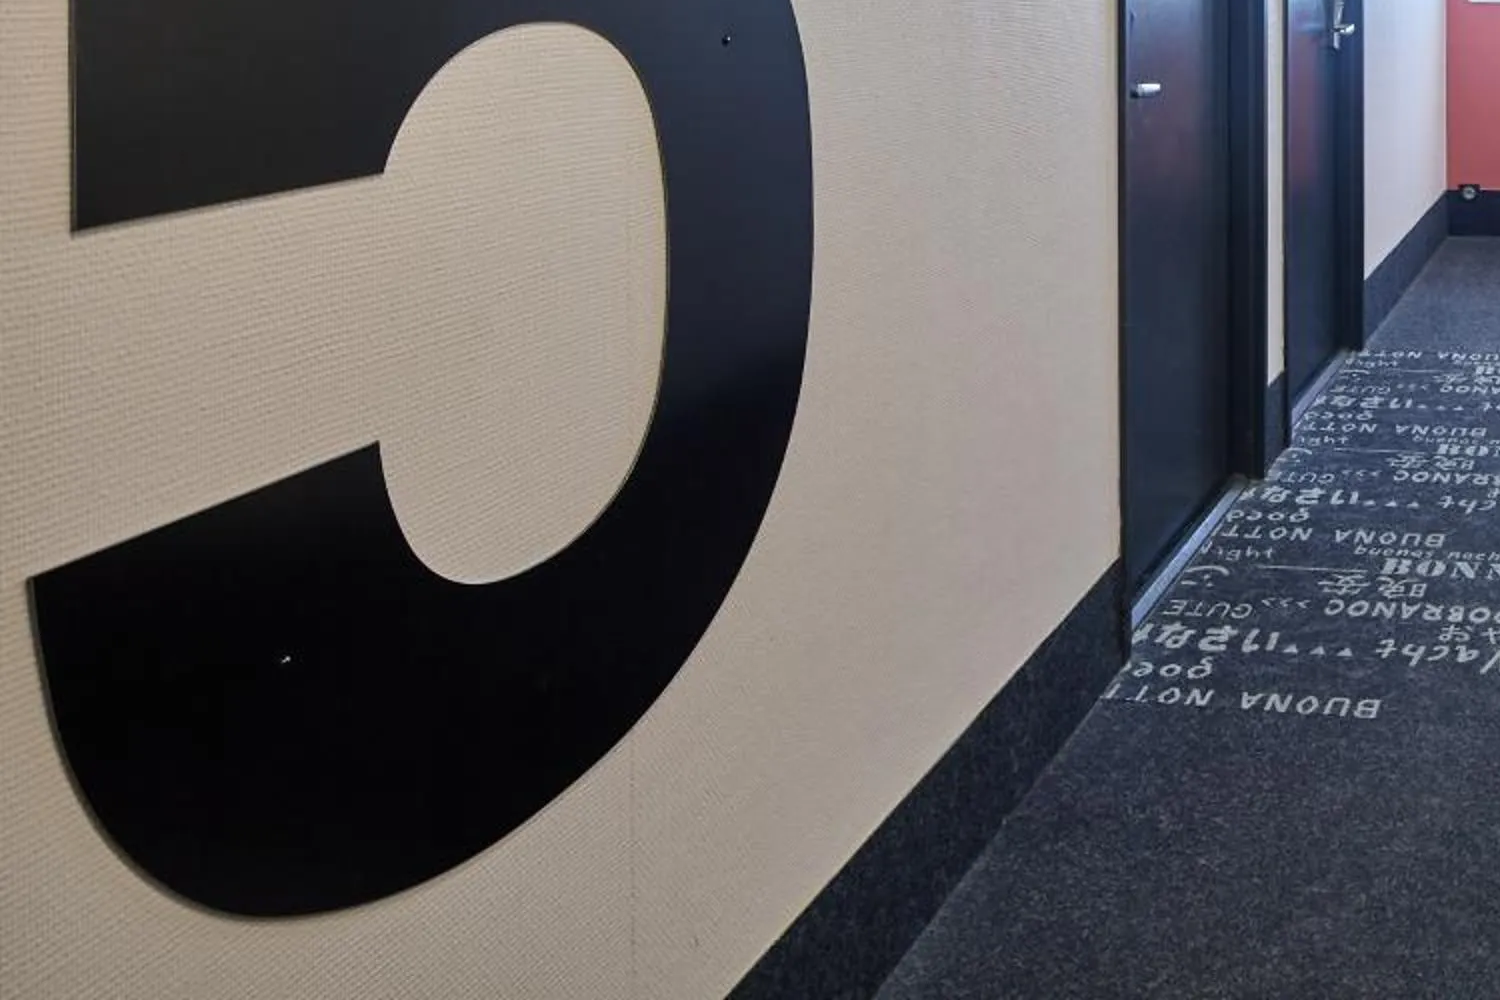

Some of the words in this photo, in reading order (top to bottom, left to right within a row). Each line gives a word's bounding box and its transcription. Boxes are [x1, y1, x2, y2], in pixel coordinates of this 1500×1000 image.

[1335, 529, 1446, 548] BUONA
[1161, 599, 1253, 619] GUTE
[1241, 691, 1382, 719] BUONA
